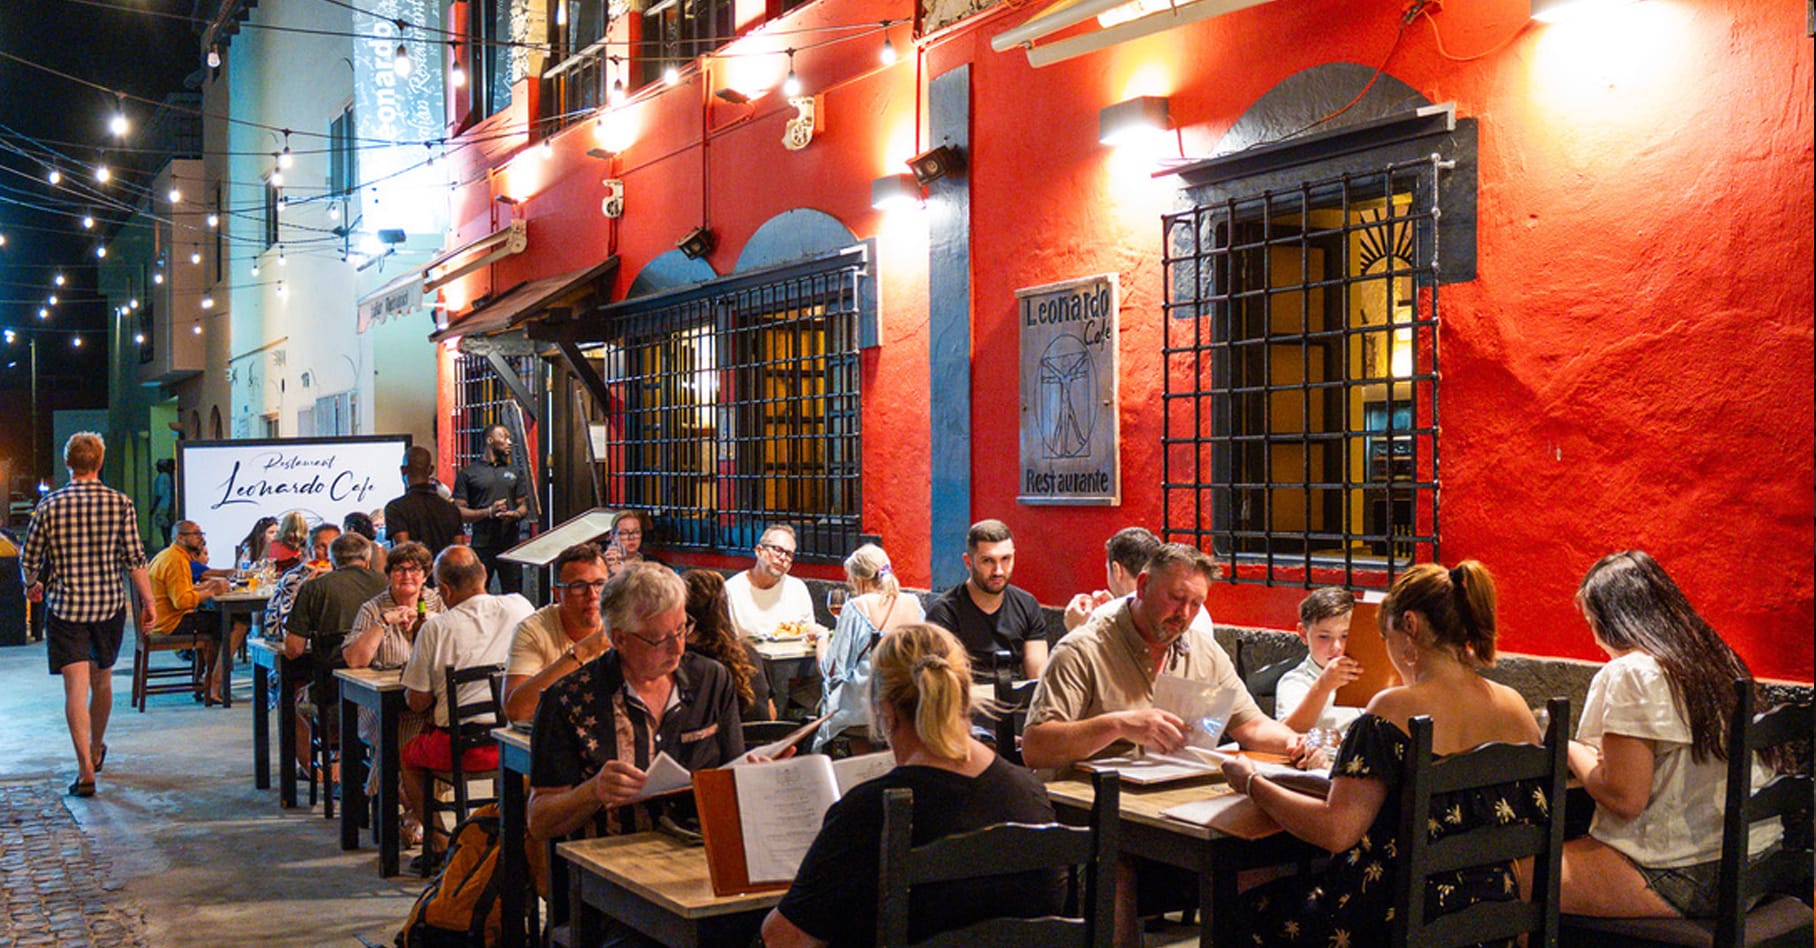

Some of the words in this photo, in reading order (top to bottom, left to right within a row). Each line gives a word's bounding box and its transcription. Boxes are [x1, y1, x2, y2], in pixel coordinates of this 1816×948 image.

[367, 20, 398, 141] eonardo
[1026, 283, 1110, 326] Leonardo
[211, 461, 325, 509] Leonardo
[1026, 466, 1109, 494] Restaurante
